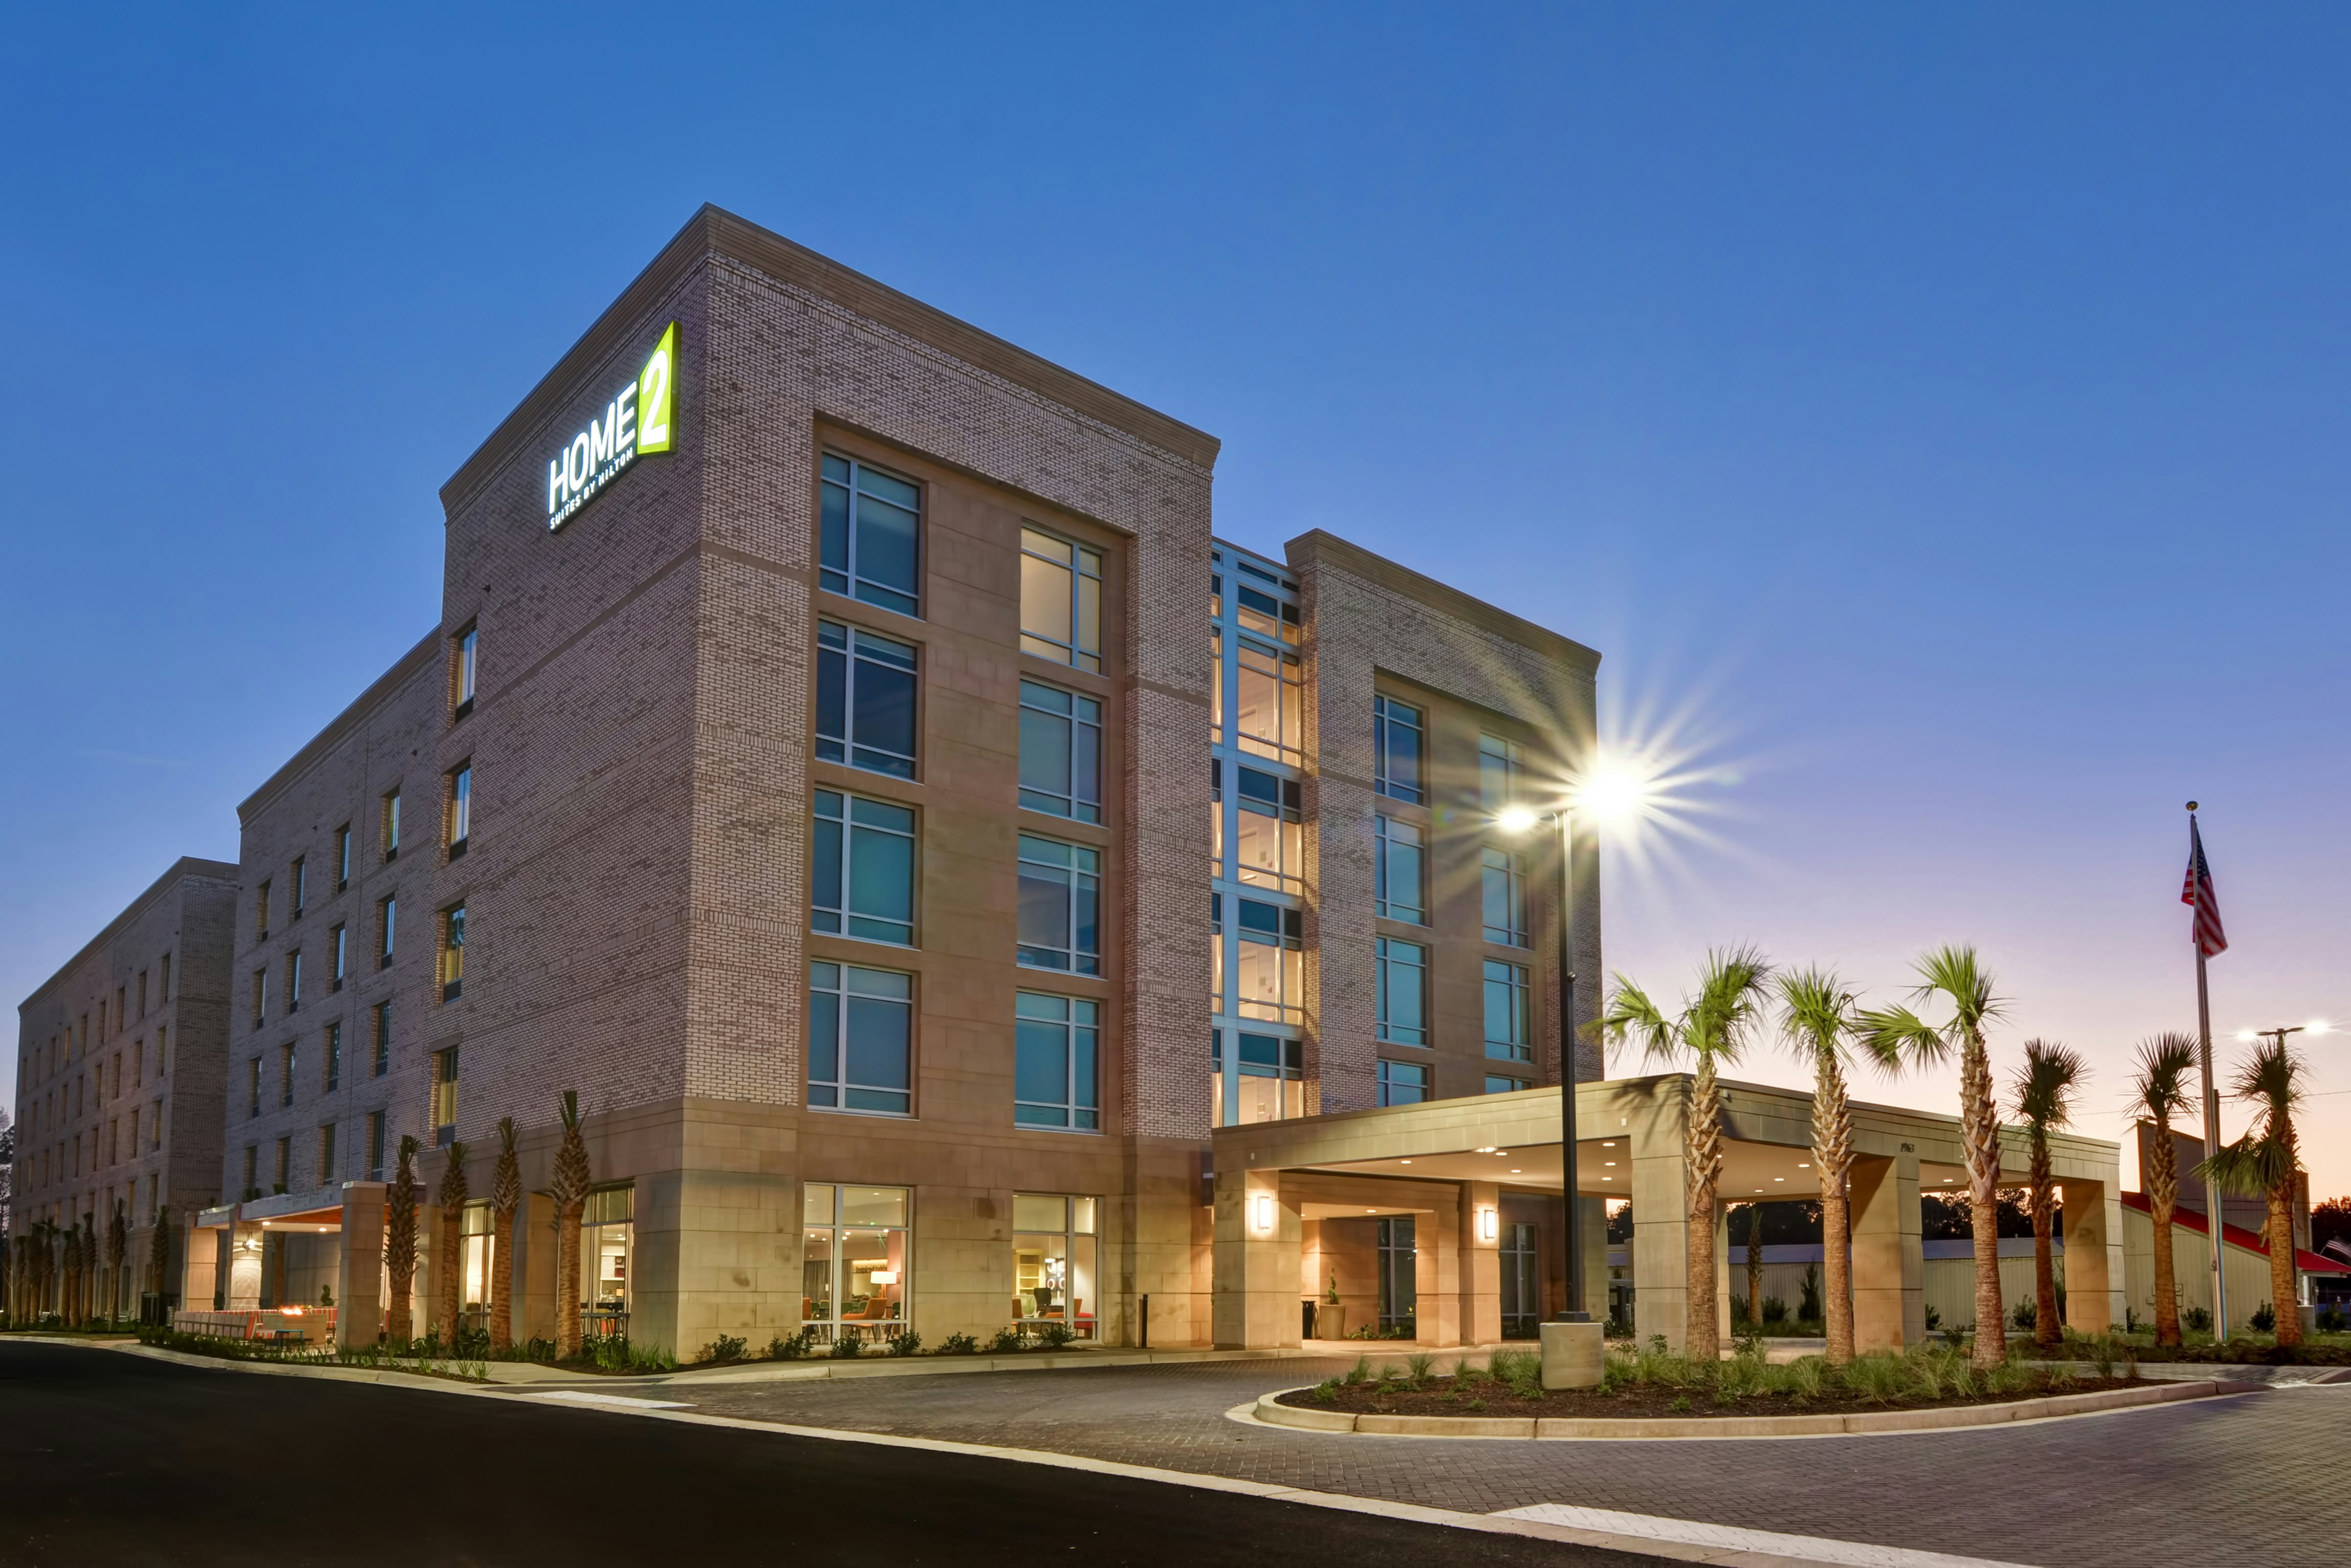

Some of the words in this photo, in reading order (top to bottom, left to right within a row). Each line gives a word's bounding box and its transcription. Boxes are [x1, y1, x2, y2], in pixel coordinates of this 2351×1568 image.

[550, 494, 581, 529] SUITES
[584, 480, 595, 499] BY
[598, 447, 633, 486] HILTON
